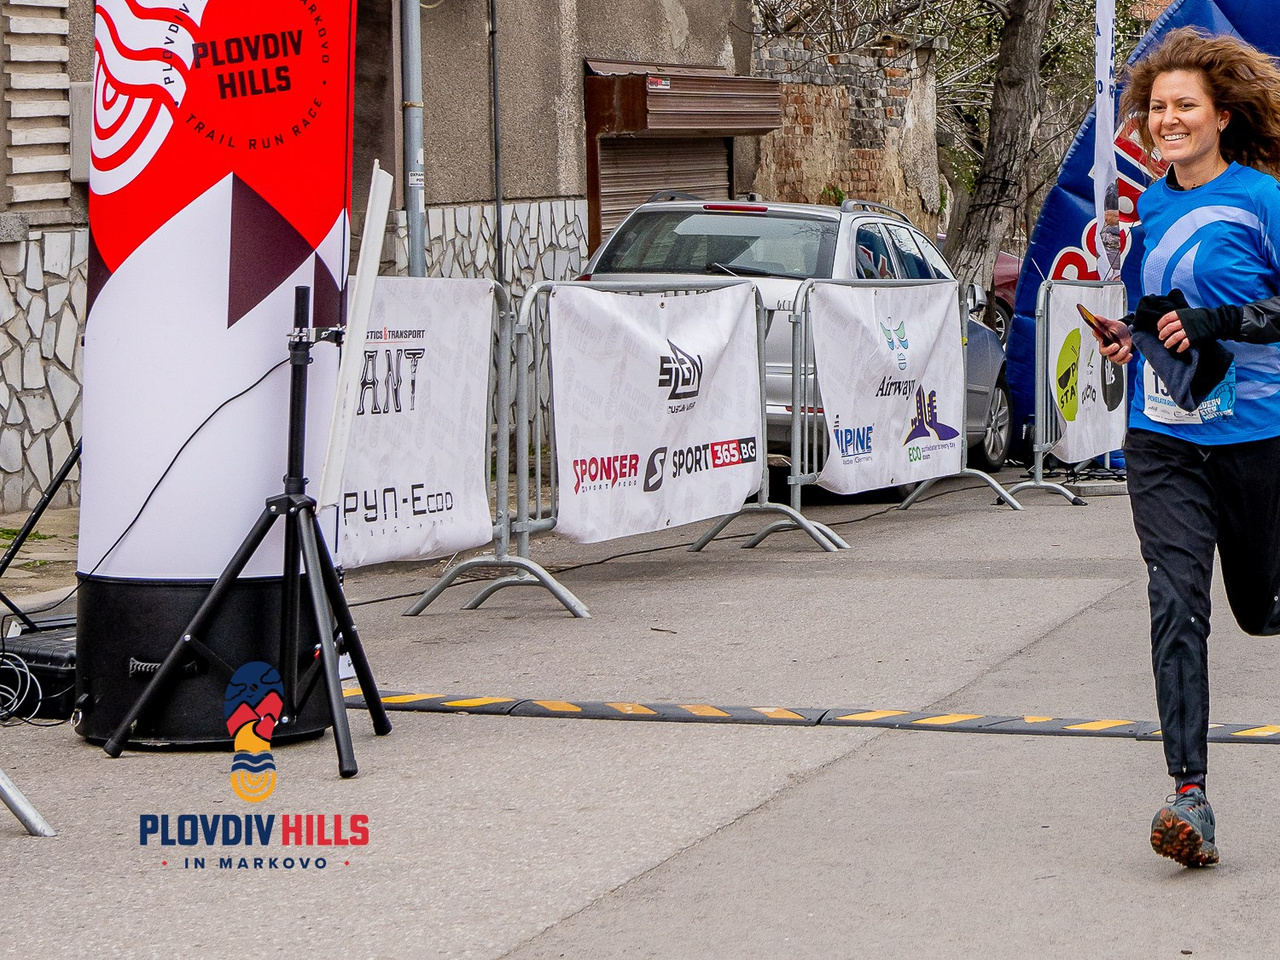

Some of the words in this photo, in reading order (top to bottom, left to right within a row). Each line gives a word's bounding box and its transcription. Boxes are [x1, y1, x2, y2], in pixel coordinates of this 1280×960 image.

[191, 30, 303, 68] PLOVDIV
[217, 65, 291, 99] HILLS
[185, 113, 235, 148] TRAIL
[248, 134, 284, 150] RUN
[292, 96, 322, 137] RACE
[573, 454, 640, 495] SPONSER
